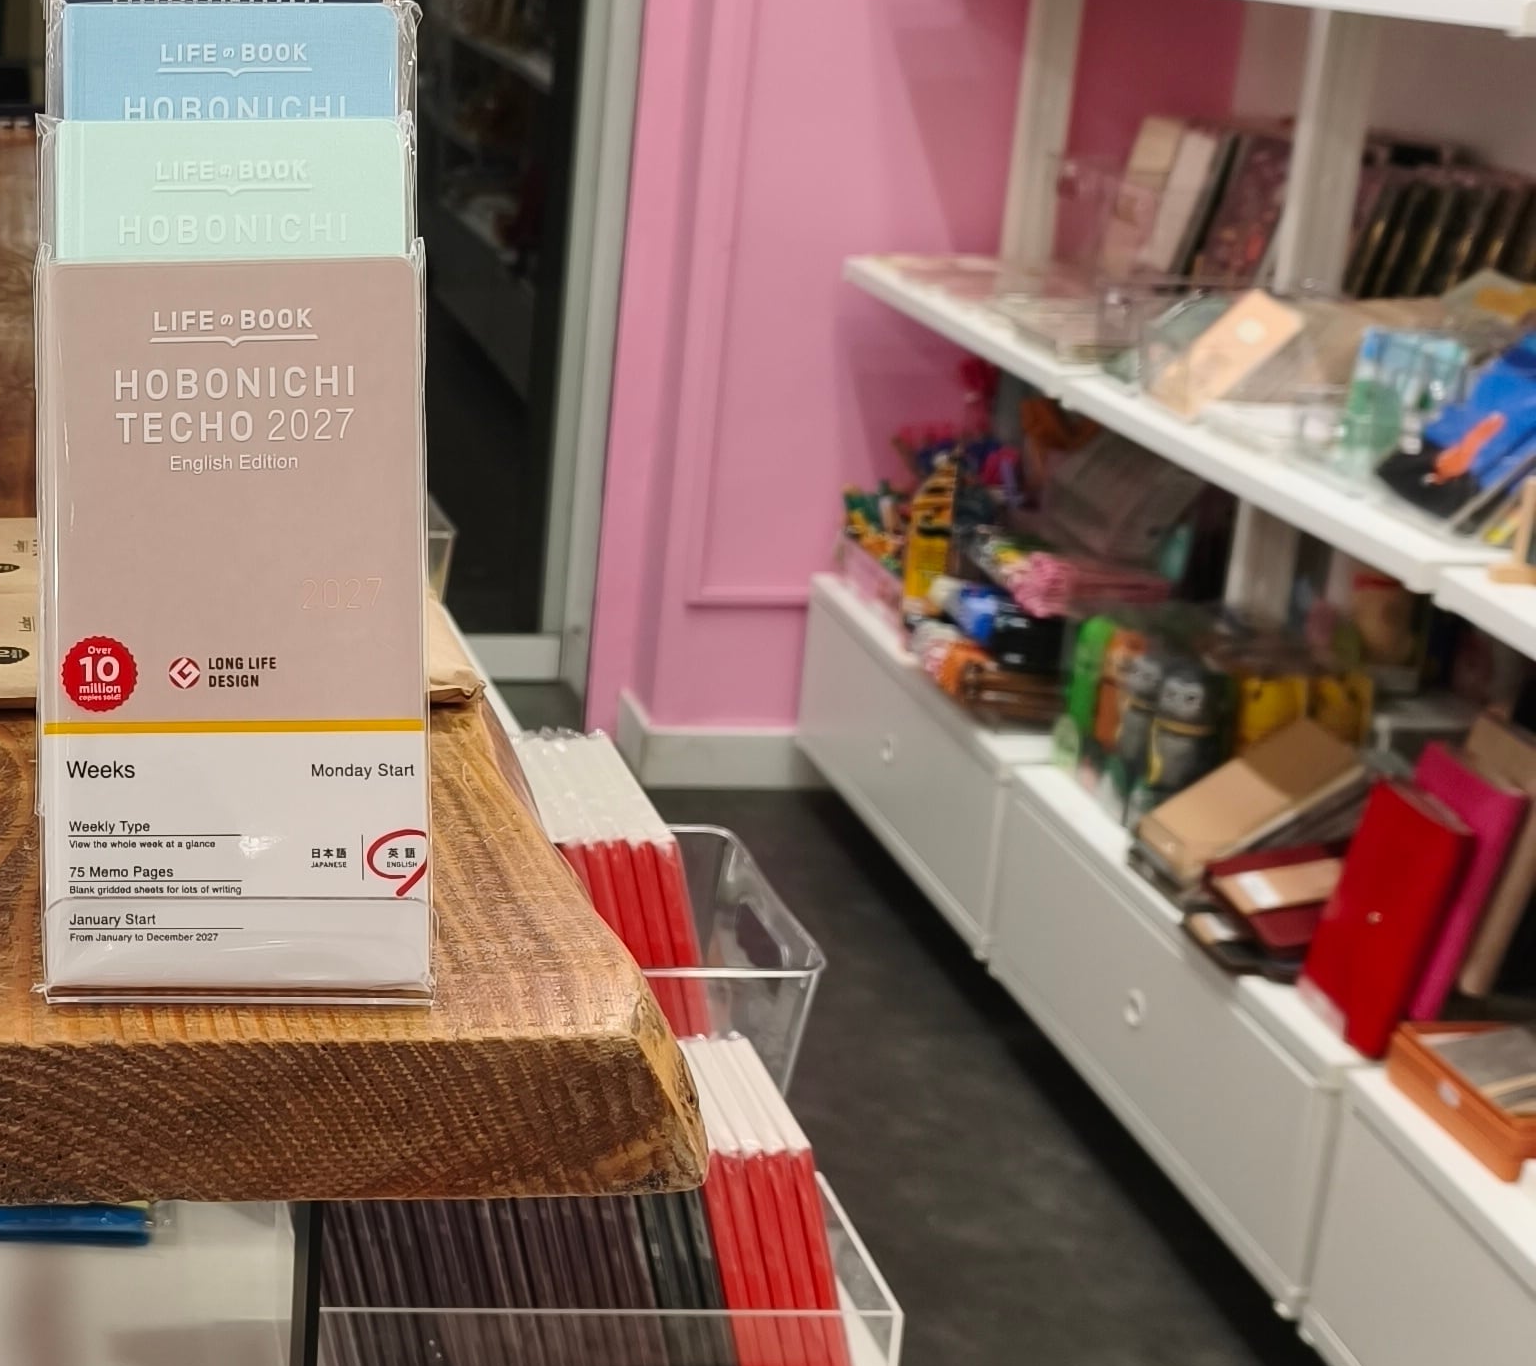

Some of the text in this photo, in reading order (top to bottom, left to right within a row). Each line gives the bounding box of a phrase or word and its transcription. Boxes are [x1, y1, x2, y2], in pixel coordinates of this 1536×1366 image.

[161, 43, 217, 63] LIFE
[241, 43, 308, 62] BOOK
[124, 95, 347, 120] HOBONICHI
[156, 160, 214, 182] LIFE
[238, 159, 308, 181] BOOK
[118, 212, 349, 245] HOBONICHI
[154, 310, 214, 332] LIFE
[240, 308, 313, 330] BOOK
[113, 365, 355, 401] HOBONICHI
[115, 408, 355, 444] TECHO 2027
[170, 454, 299, 474] English Edition
[300, 578, 383, 610] 2027
[88, 646, 112, 654] Over
[79, 656, 119, 682] 10
[208, 656, 277, 671] LONG LIFE
[79, 683, 121, 694] million
[208, 674, 259, 688] DESIGN
[66, 760, 135, 779] Weeks
[311, 763, 415, 780] Monday Start
[69, 820, 150, 834] Weekly Type
[69, 840, 91, 848] View
[93, 840, 107, 848] the
[109, 840, 136, 849] whole
[139, 840, 163, 849] week
[166, 840, 174, 849] at
[186, 840, 215, 850] glance
[311, 848, 347, 859] 日本語
[69, 866, 174, 881] 75 Memo Pages
[69, 885, 242, 896] Blank gridded sheets for lots of writing
[69, 913, 156, 927] January Start
[70, 933, 93, 941] From
[95, 933, 133, 943] January
[146, 932, 194, 942] December
[196, 933, 219, 941] 2027
